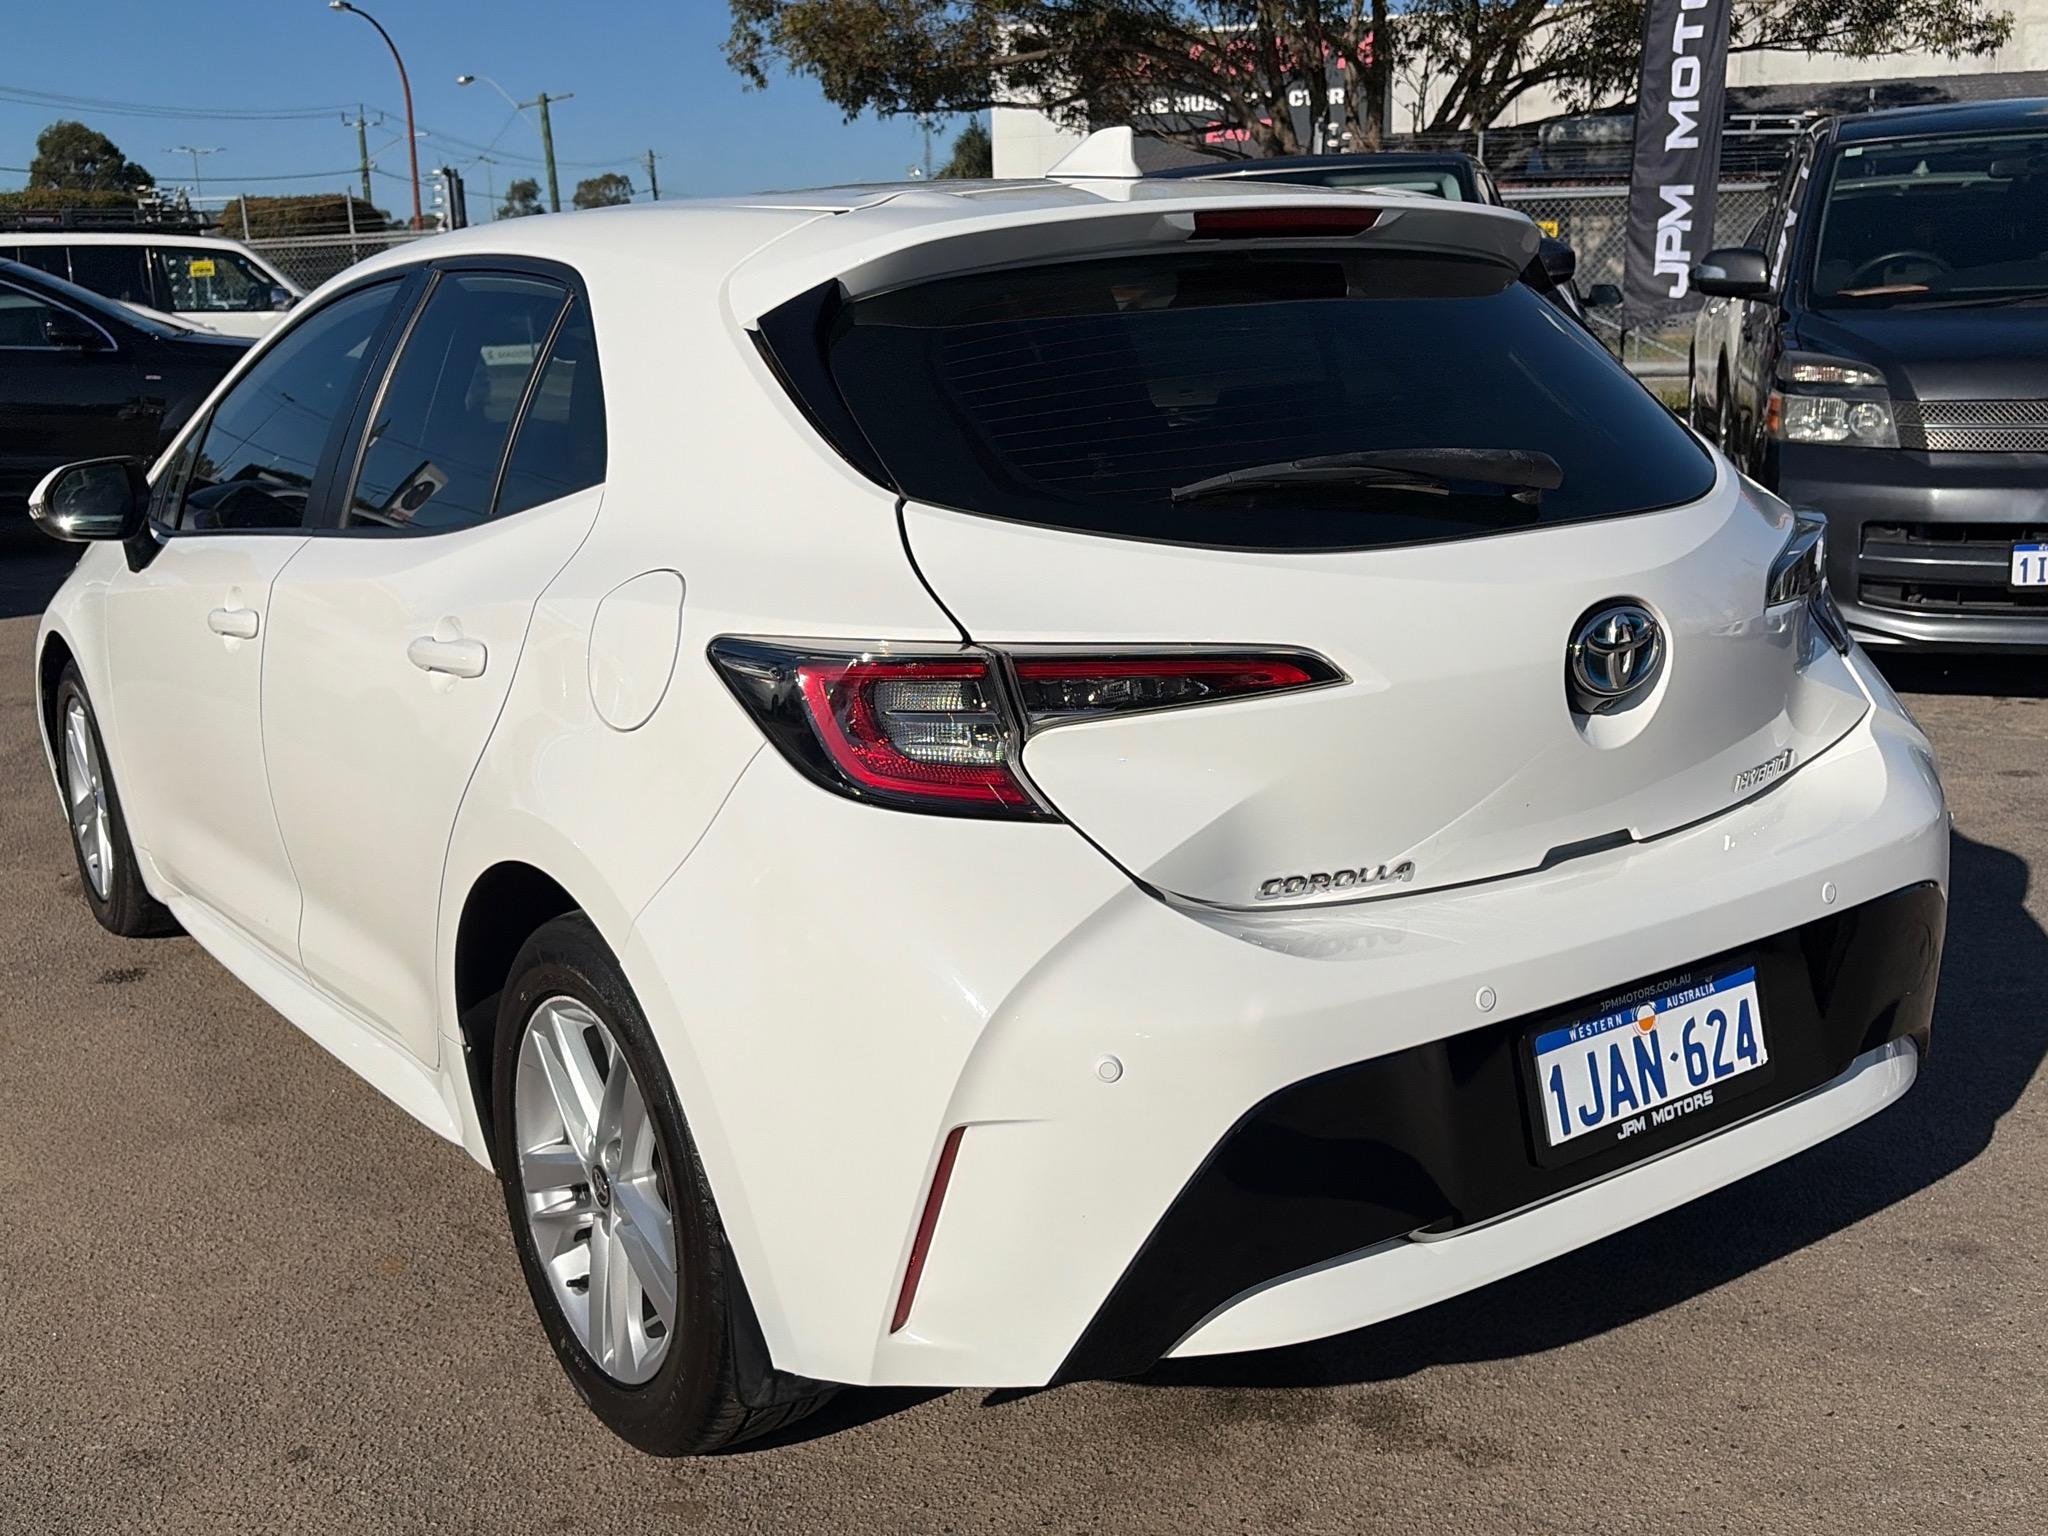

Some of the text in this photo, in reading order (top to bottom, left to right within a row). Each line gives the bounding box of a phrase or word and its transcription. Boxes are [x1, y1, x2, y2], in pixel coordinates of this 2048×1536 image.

[1653, 0, 1708, 299] JPM MOT
[1733, 748, 1796, 793] HYBRID
[1254, 861, 1416, 900] COROLLA
[1568, 982, 1716, 1041] WESTERN AUSTRALIA
[1600, 973, 1691, 1012] JPMMOTORS.COM.AU
[1616, 1090, 1714, 1140] JPM MOTORS
